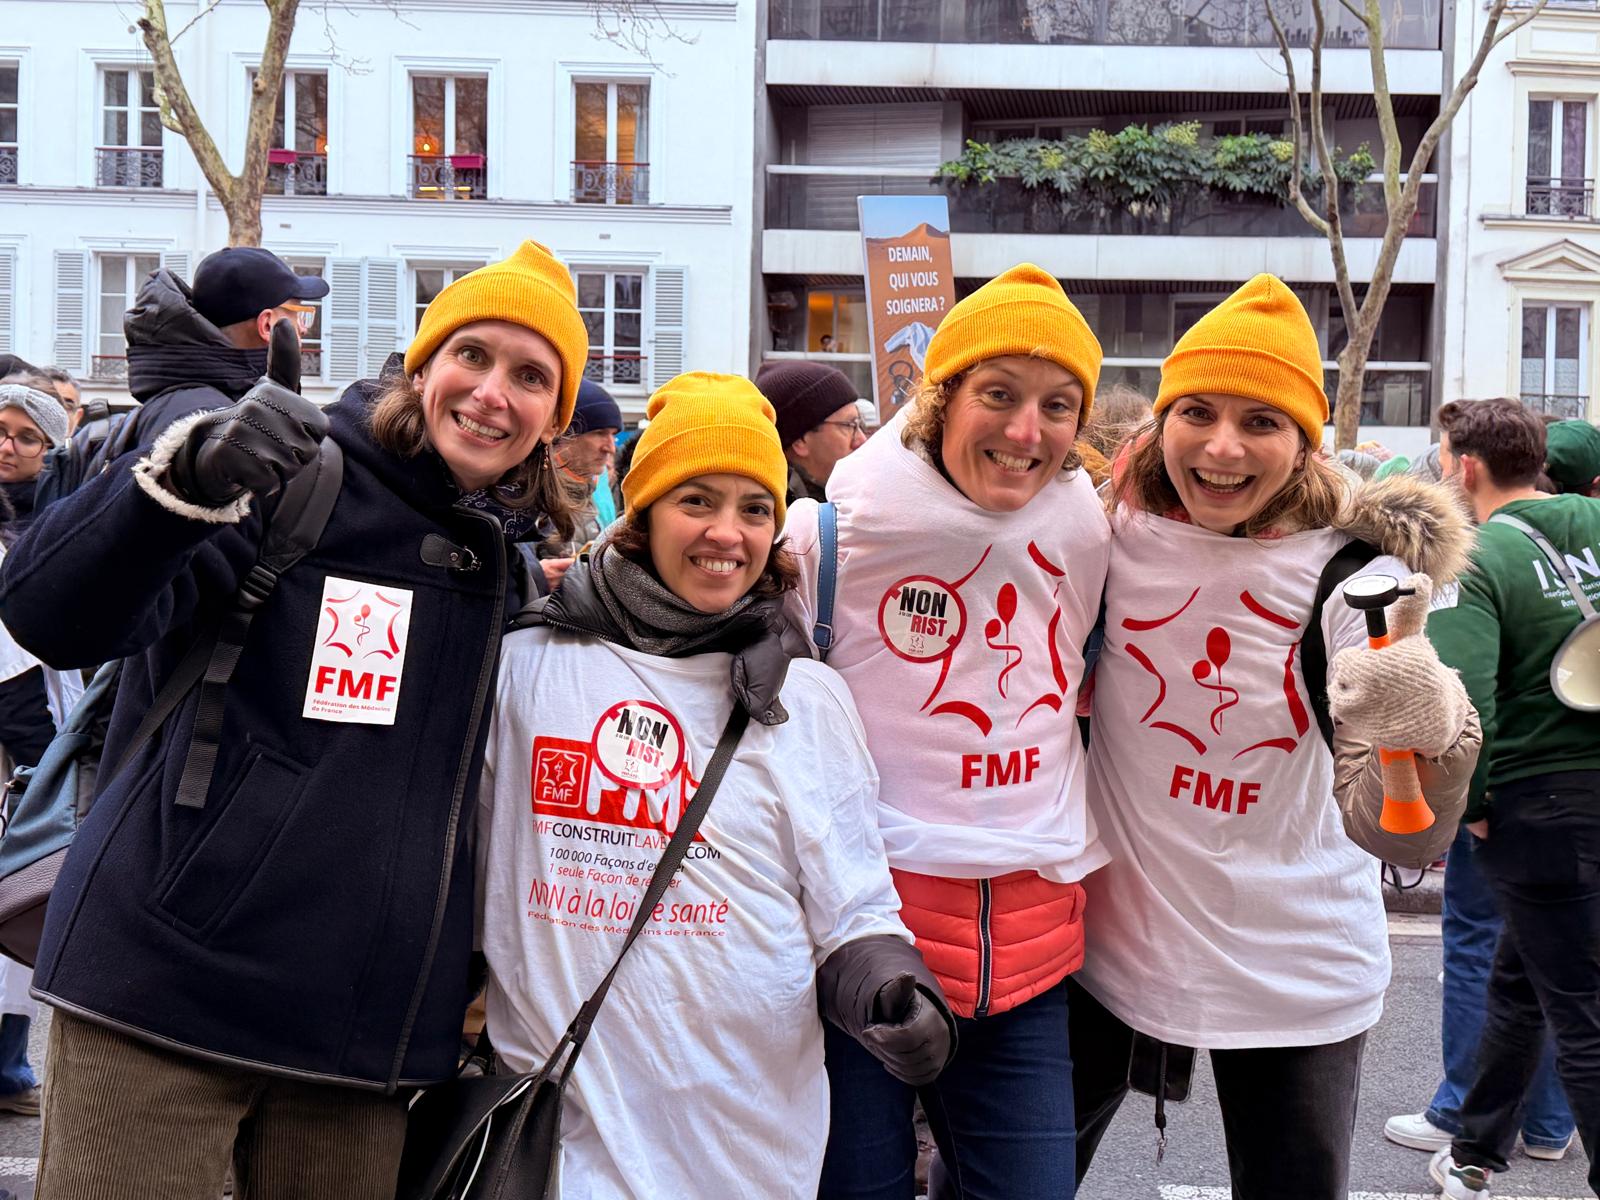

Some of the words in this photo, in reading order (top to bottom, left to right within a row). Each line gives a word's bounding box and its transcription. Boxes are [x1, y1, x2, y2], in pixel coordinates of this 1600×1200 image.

[888, 246, 933, 263] DEMAIN,
[889, 274, 909, 291] QUI
[911, 272, 939, 287] VOUS
[886, 297, 938, 315] SOIGNERA
[939, 296, 945, 311] ?
[899, 586, 948, 618] NON
[910, 614, 948, 637] RIST
[315, 665, 397, 701] FMF
[617, 708, 669, 749] NON
[961, 746, 1040, 789] FMF
[542, 786, 573, 802] FMF
[1169, 764, 1261, 815] FMF
[593, 853, 635, 871] Façons
[549, 863, 554, 873] 1
[557, 864, 585, 879] seule
[586, 868, 622, 885] Façon
[625, 873, 639, 885] de
[567, 887, 581, 915] à
[585, 889, 606, 919] la
[609, 891, 637, 921] loi
[668, 897, 730, 924] santé
[579, 923, 600, 932] des
[665, 928, 681, 937] de
[684, 928, 726, 937] France
